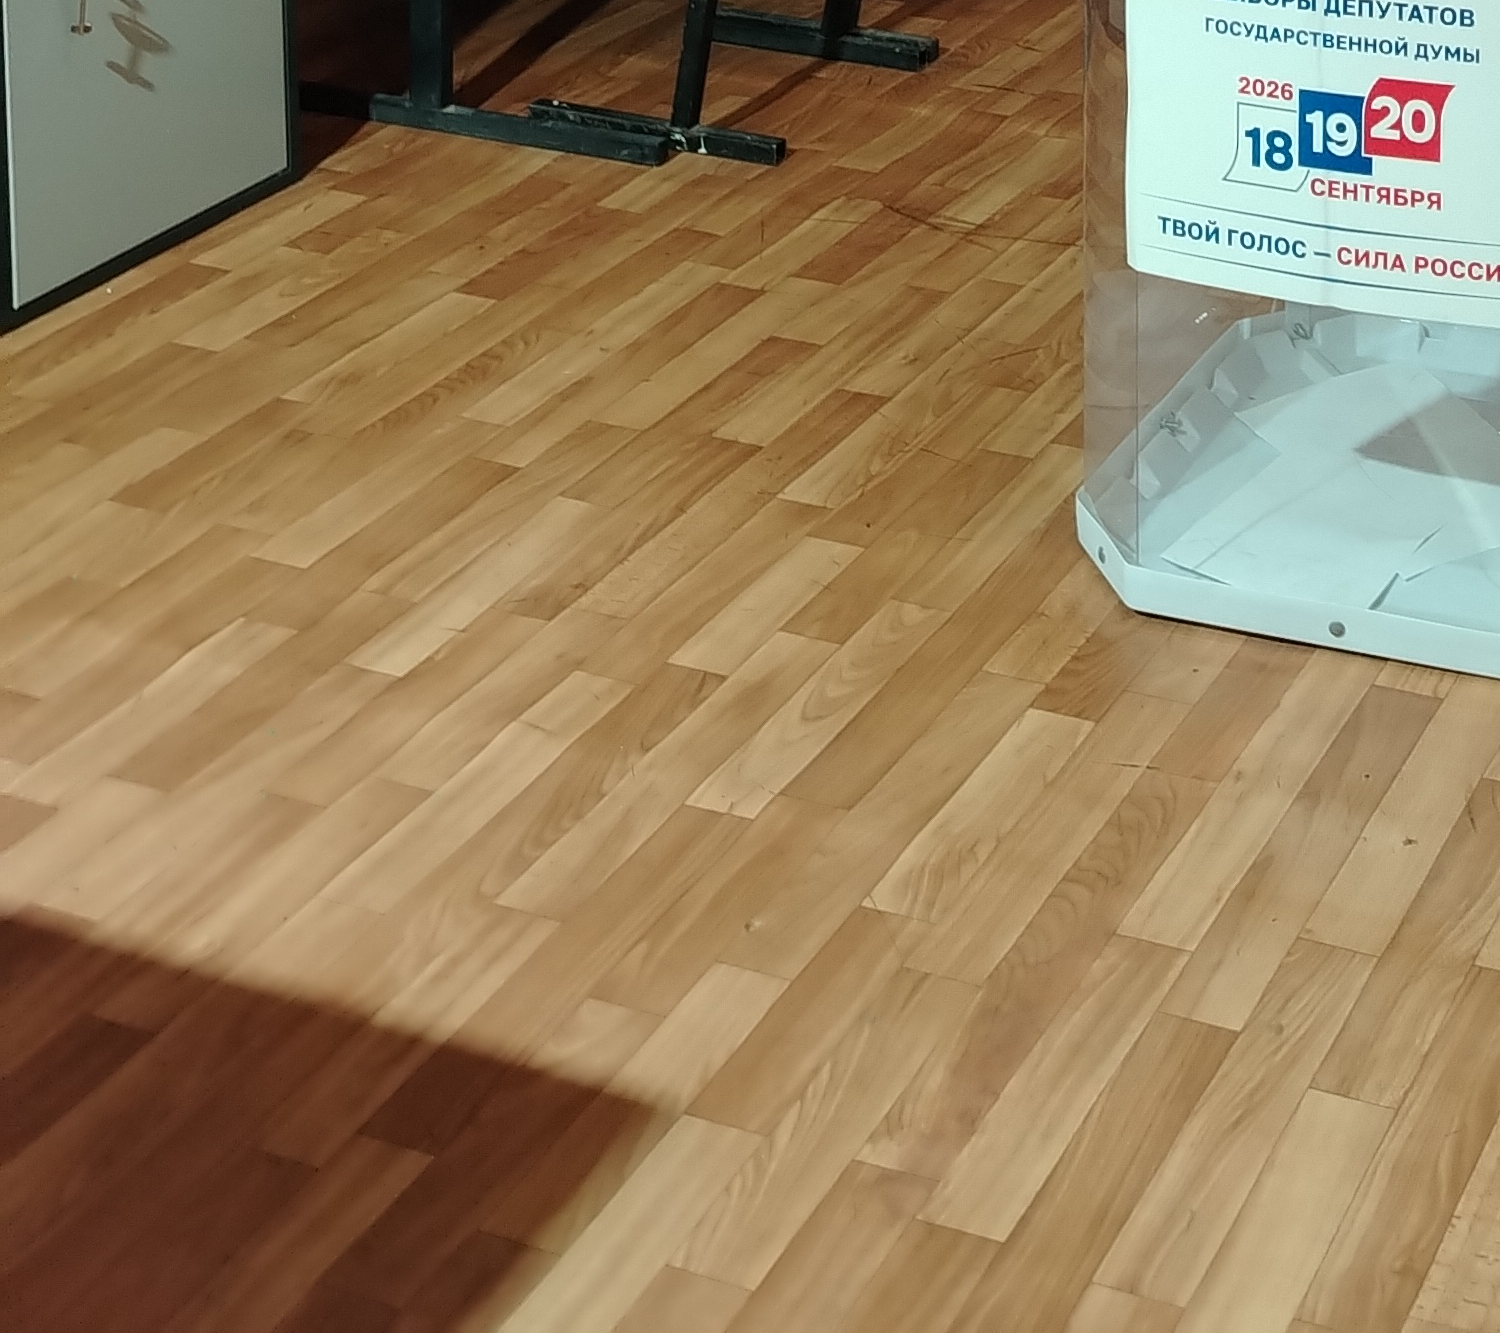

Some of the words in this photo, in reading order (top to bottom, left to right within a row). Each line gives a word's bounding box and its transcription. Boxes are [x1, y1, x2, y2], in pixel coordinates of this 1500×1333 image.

[1205, 17, 1408, 57] ГОСУДАРСТВЕННОЙ
[1414, 43, 1480, 64] ДУМЫ
[1237, 76, 1294, 101] 2026
[1244, 127, 1294, 172] 18
[1305, 110, 1358, 157] 19
[1370, 96, 1436, 144] 20
[1310, 178, 1442, 211] СЕНТЯБРЯ
[1157, 215, 1220, 245] ТВОЙ
[1227, 228, 1308, 259] ГОЛОС
[1336, 246, 1406, 273] СИЛА
